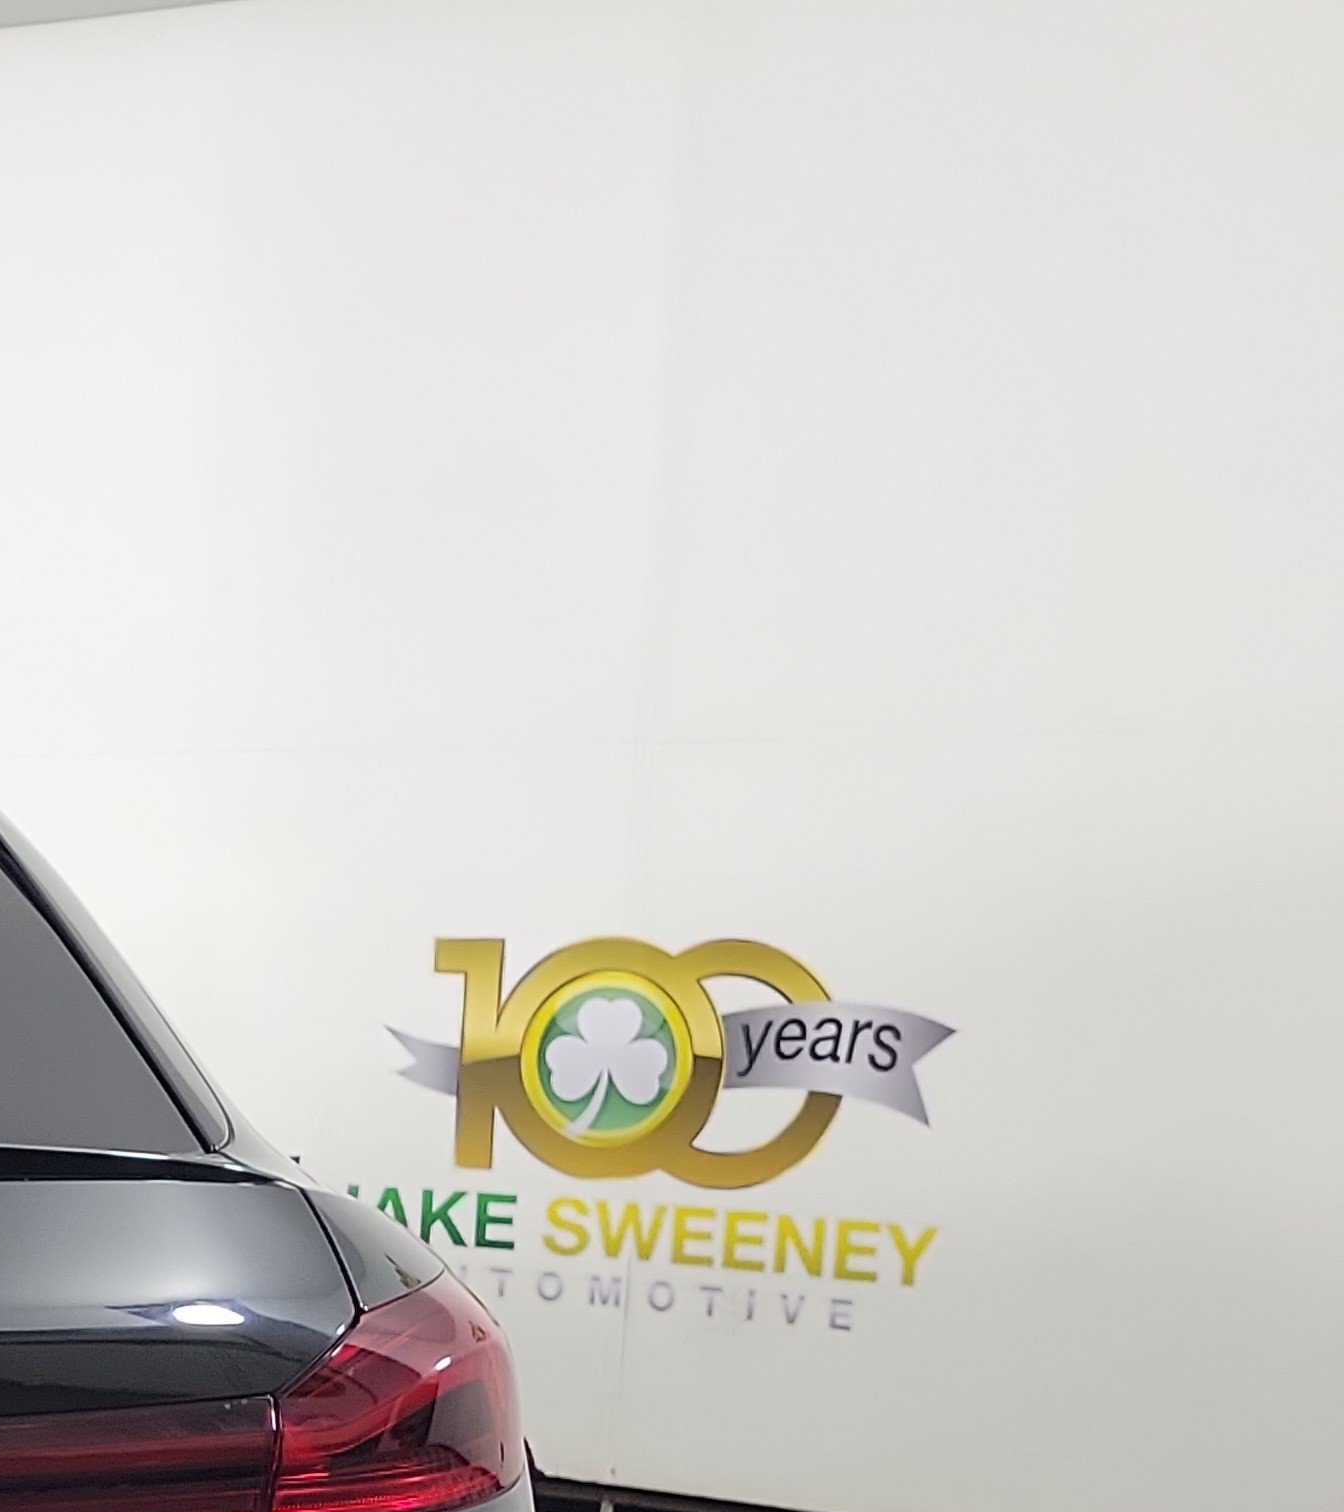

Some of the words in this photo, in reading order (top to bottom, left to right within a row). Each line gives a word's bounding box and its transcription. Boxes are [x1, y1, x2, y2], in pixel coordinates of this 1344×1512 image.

[434, 936, 843, 1190] 100
[737, 1017, 903, 1073] years
[348, 1184, 518, 1250] AKE
[542, 1196, 939, 1287] SWEENEY
[460, 1265, 854, 1331] TOMOTIVE
